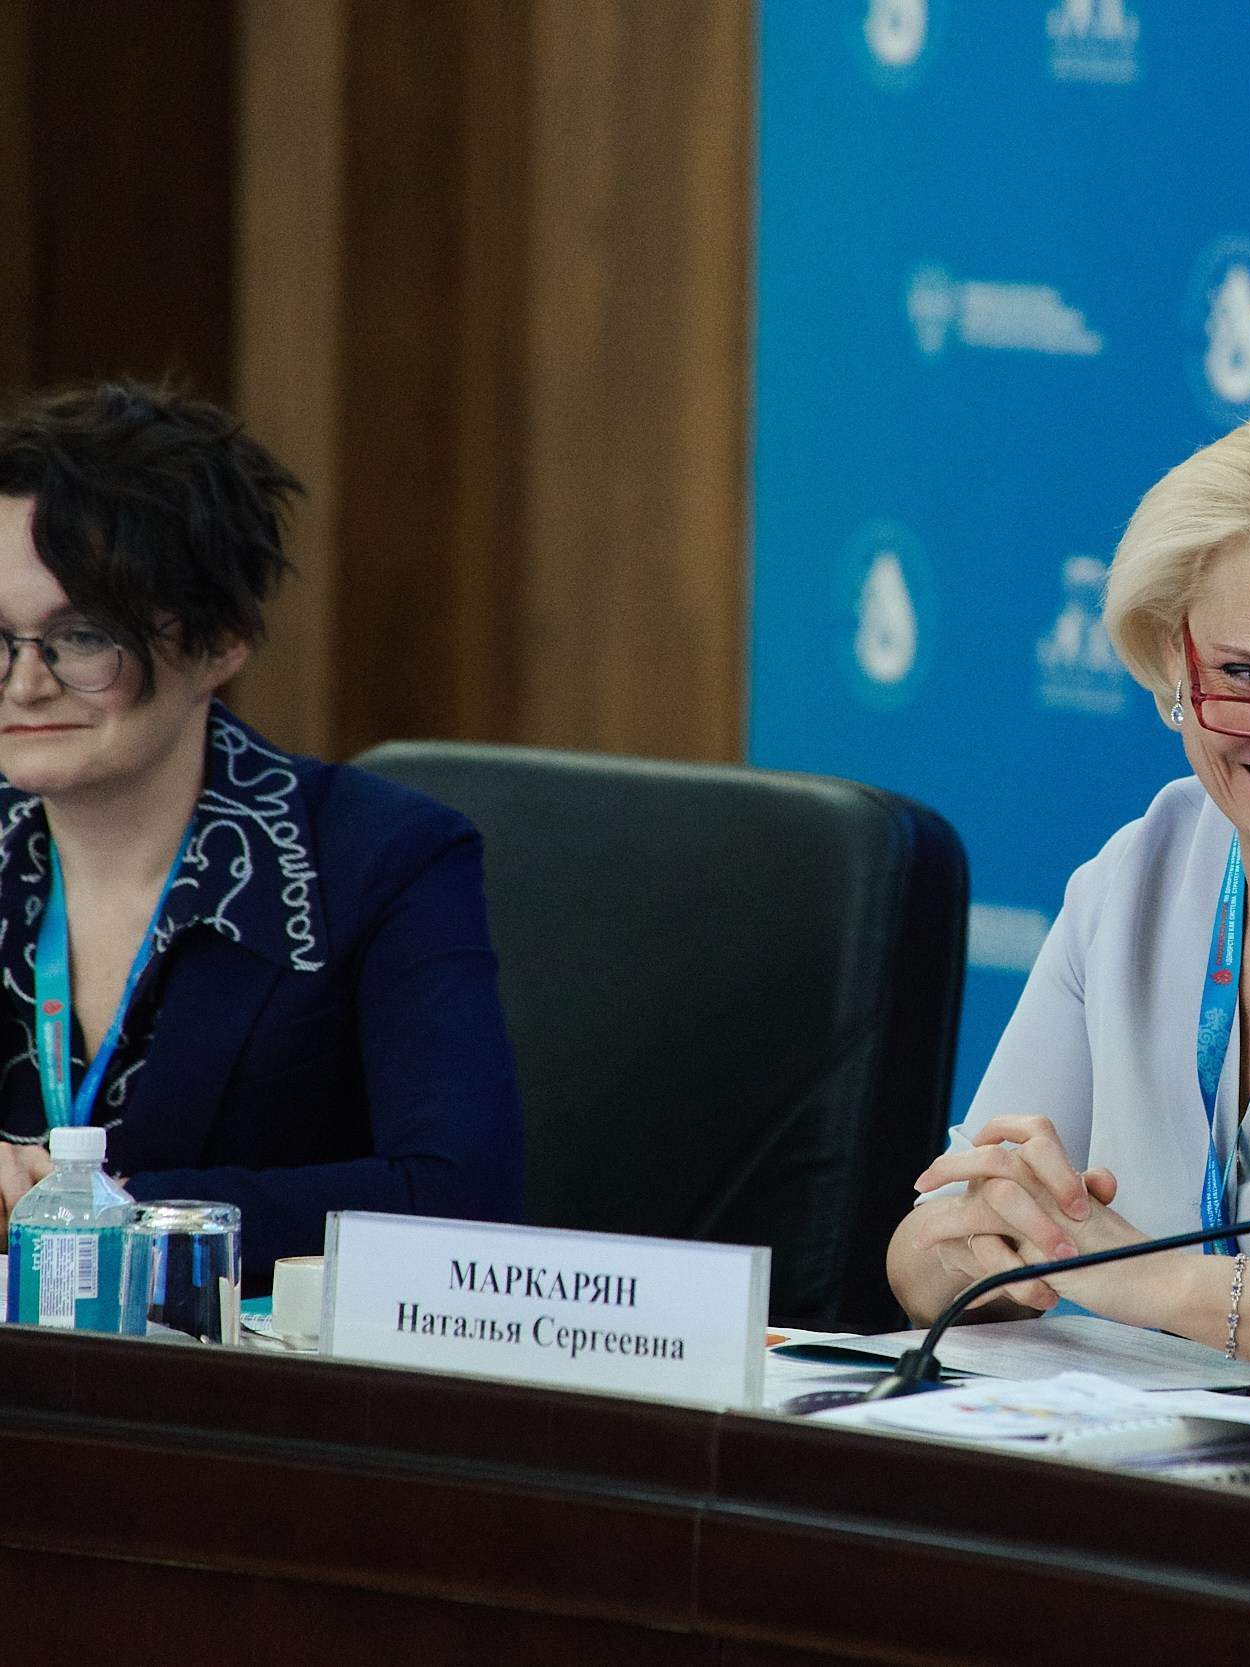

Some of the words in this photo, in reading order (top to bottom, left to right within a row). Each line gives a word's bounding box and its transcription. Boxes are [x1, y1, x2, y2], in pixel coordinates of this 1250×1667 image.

[449, 1259, 638, 1307] МАРКАРЯН
[396, 1301, 522, 1344] Наталья
[532, 1315, 686, 1360] Сергеевна
